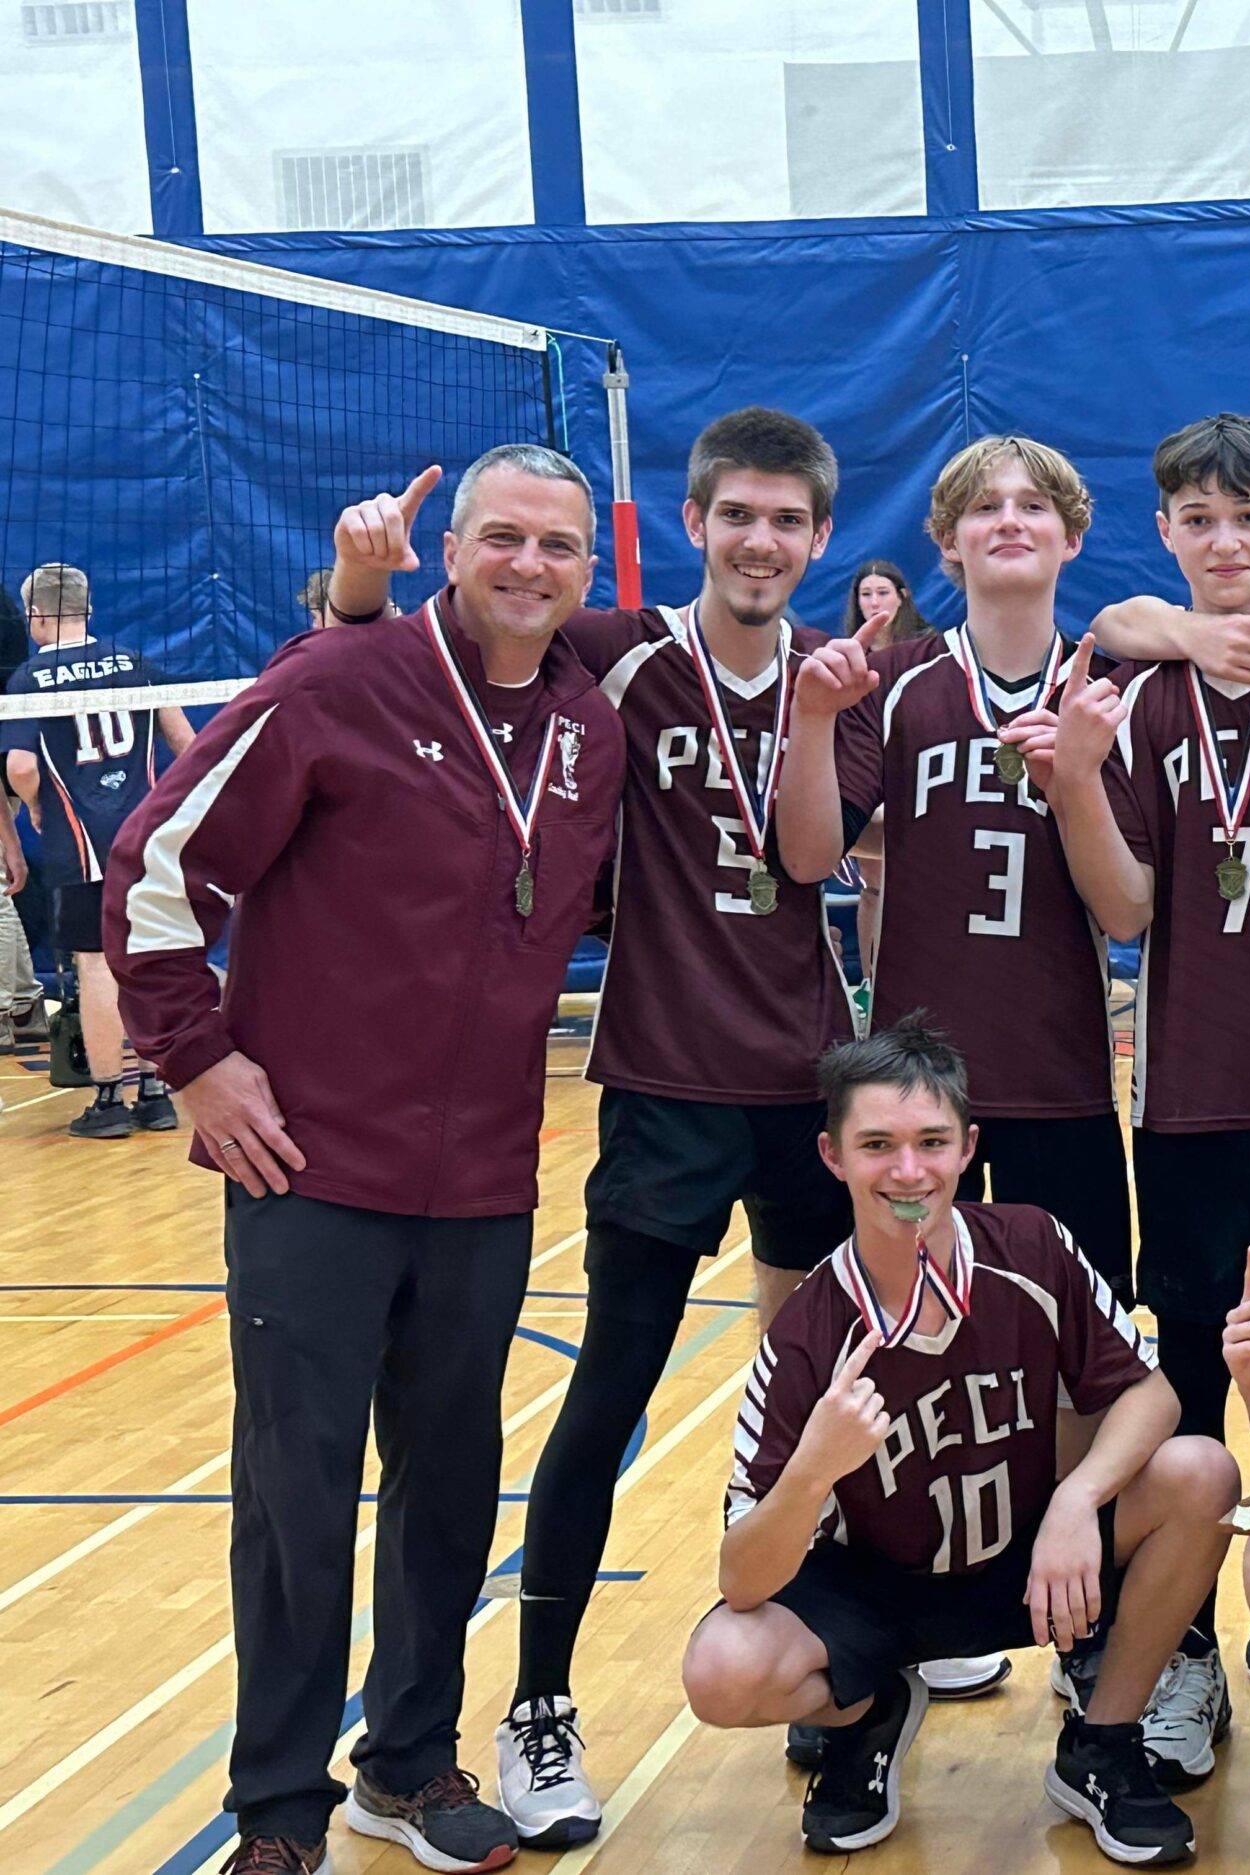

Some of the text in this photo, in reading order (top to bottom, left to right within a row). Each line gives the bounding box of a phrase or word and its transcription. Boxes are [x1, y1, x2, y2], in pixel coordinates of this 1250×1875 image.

[33, 654, 134, 688] EAGLES
[75, 711, 135, 763] 10
[557, 715, 586, 736] PECI
[656, 726, 790, 800] PEC
[914, 737, 1049, 819] PEC
[968, 829, 1026, 936] 3
[875, 1368, 1035, 1499] PECI
[928, 1459, 1013, 1574] 10
